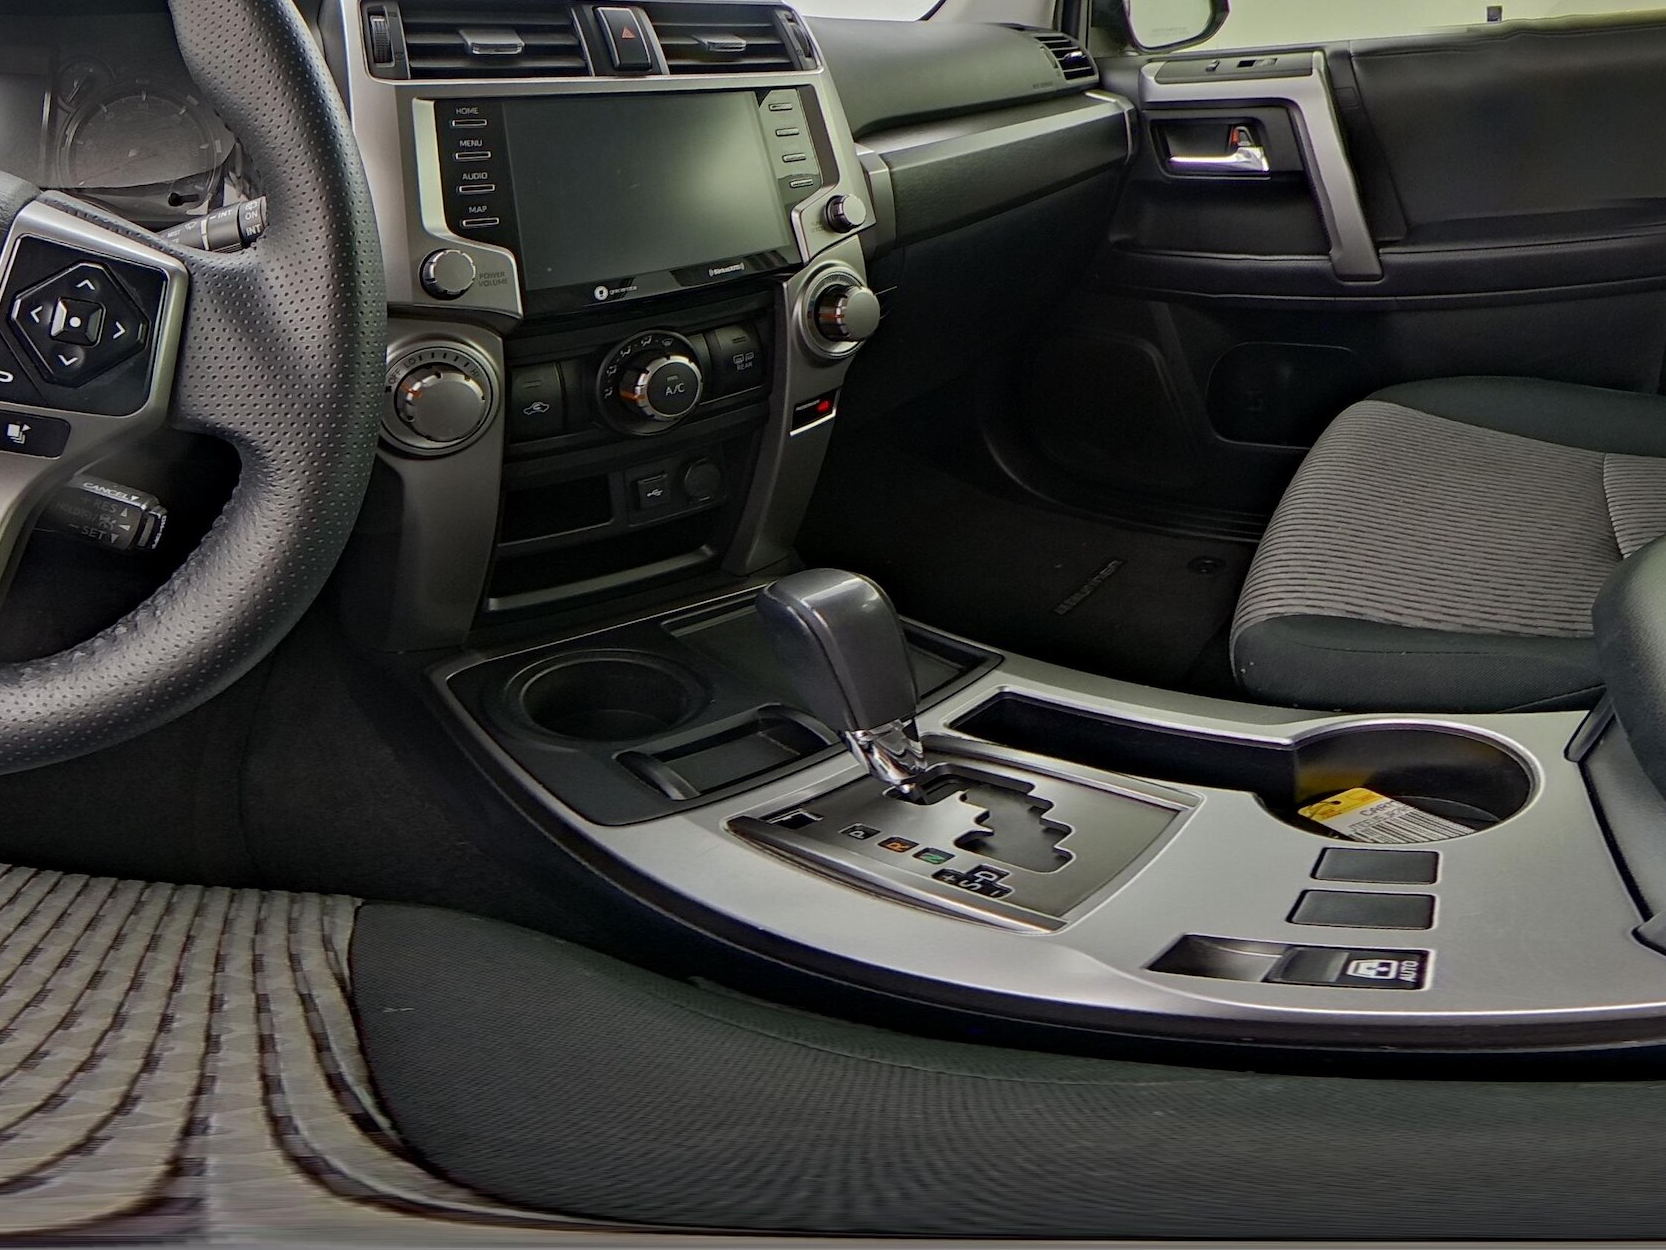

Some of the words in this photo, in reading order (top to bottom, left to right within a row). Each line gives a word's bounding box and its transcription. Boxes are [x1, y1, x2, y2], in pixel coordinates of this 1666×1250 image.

[455, 107, 480, 115] HOME
[459, 139, 483, 147] MENU
[461, 171, 488, 180] AUDIO
[217, 209, 234, 220] INT
[244, 210, 259, 221] ON
[468, 205, 488, 214] MAP
[246, 223, 262, 236] INT
[478, 270, 506, 280] POWER
[478, 277, 509, 288] VOLUME
[403, 357, 417, 369] LO
[736, 361, 754, 371] REAR
[387, 369, 402, 385] OFF
[665, 382, 685, 396] A/C
[83, 482, 130, 500] CANCEL
[93, 498, 119, 513] RES
[80, 525, 108, 541] SET
[848, 829, 867, 841] P
[885, 841, 910, 853] R
[921, 852, 946, 865] N
[973, 870, 999, 883] D
[958, 879, 984, 891] S
[1397, 960, 1420, 984] AUTO
